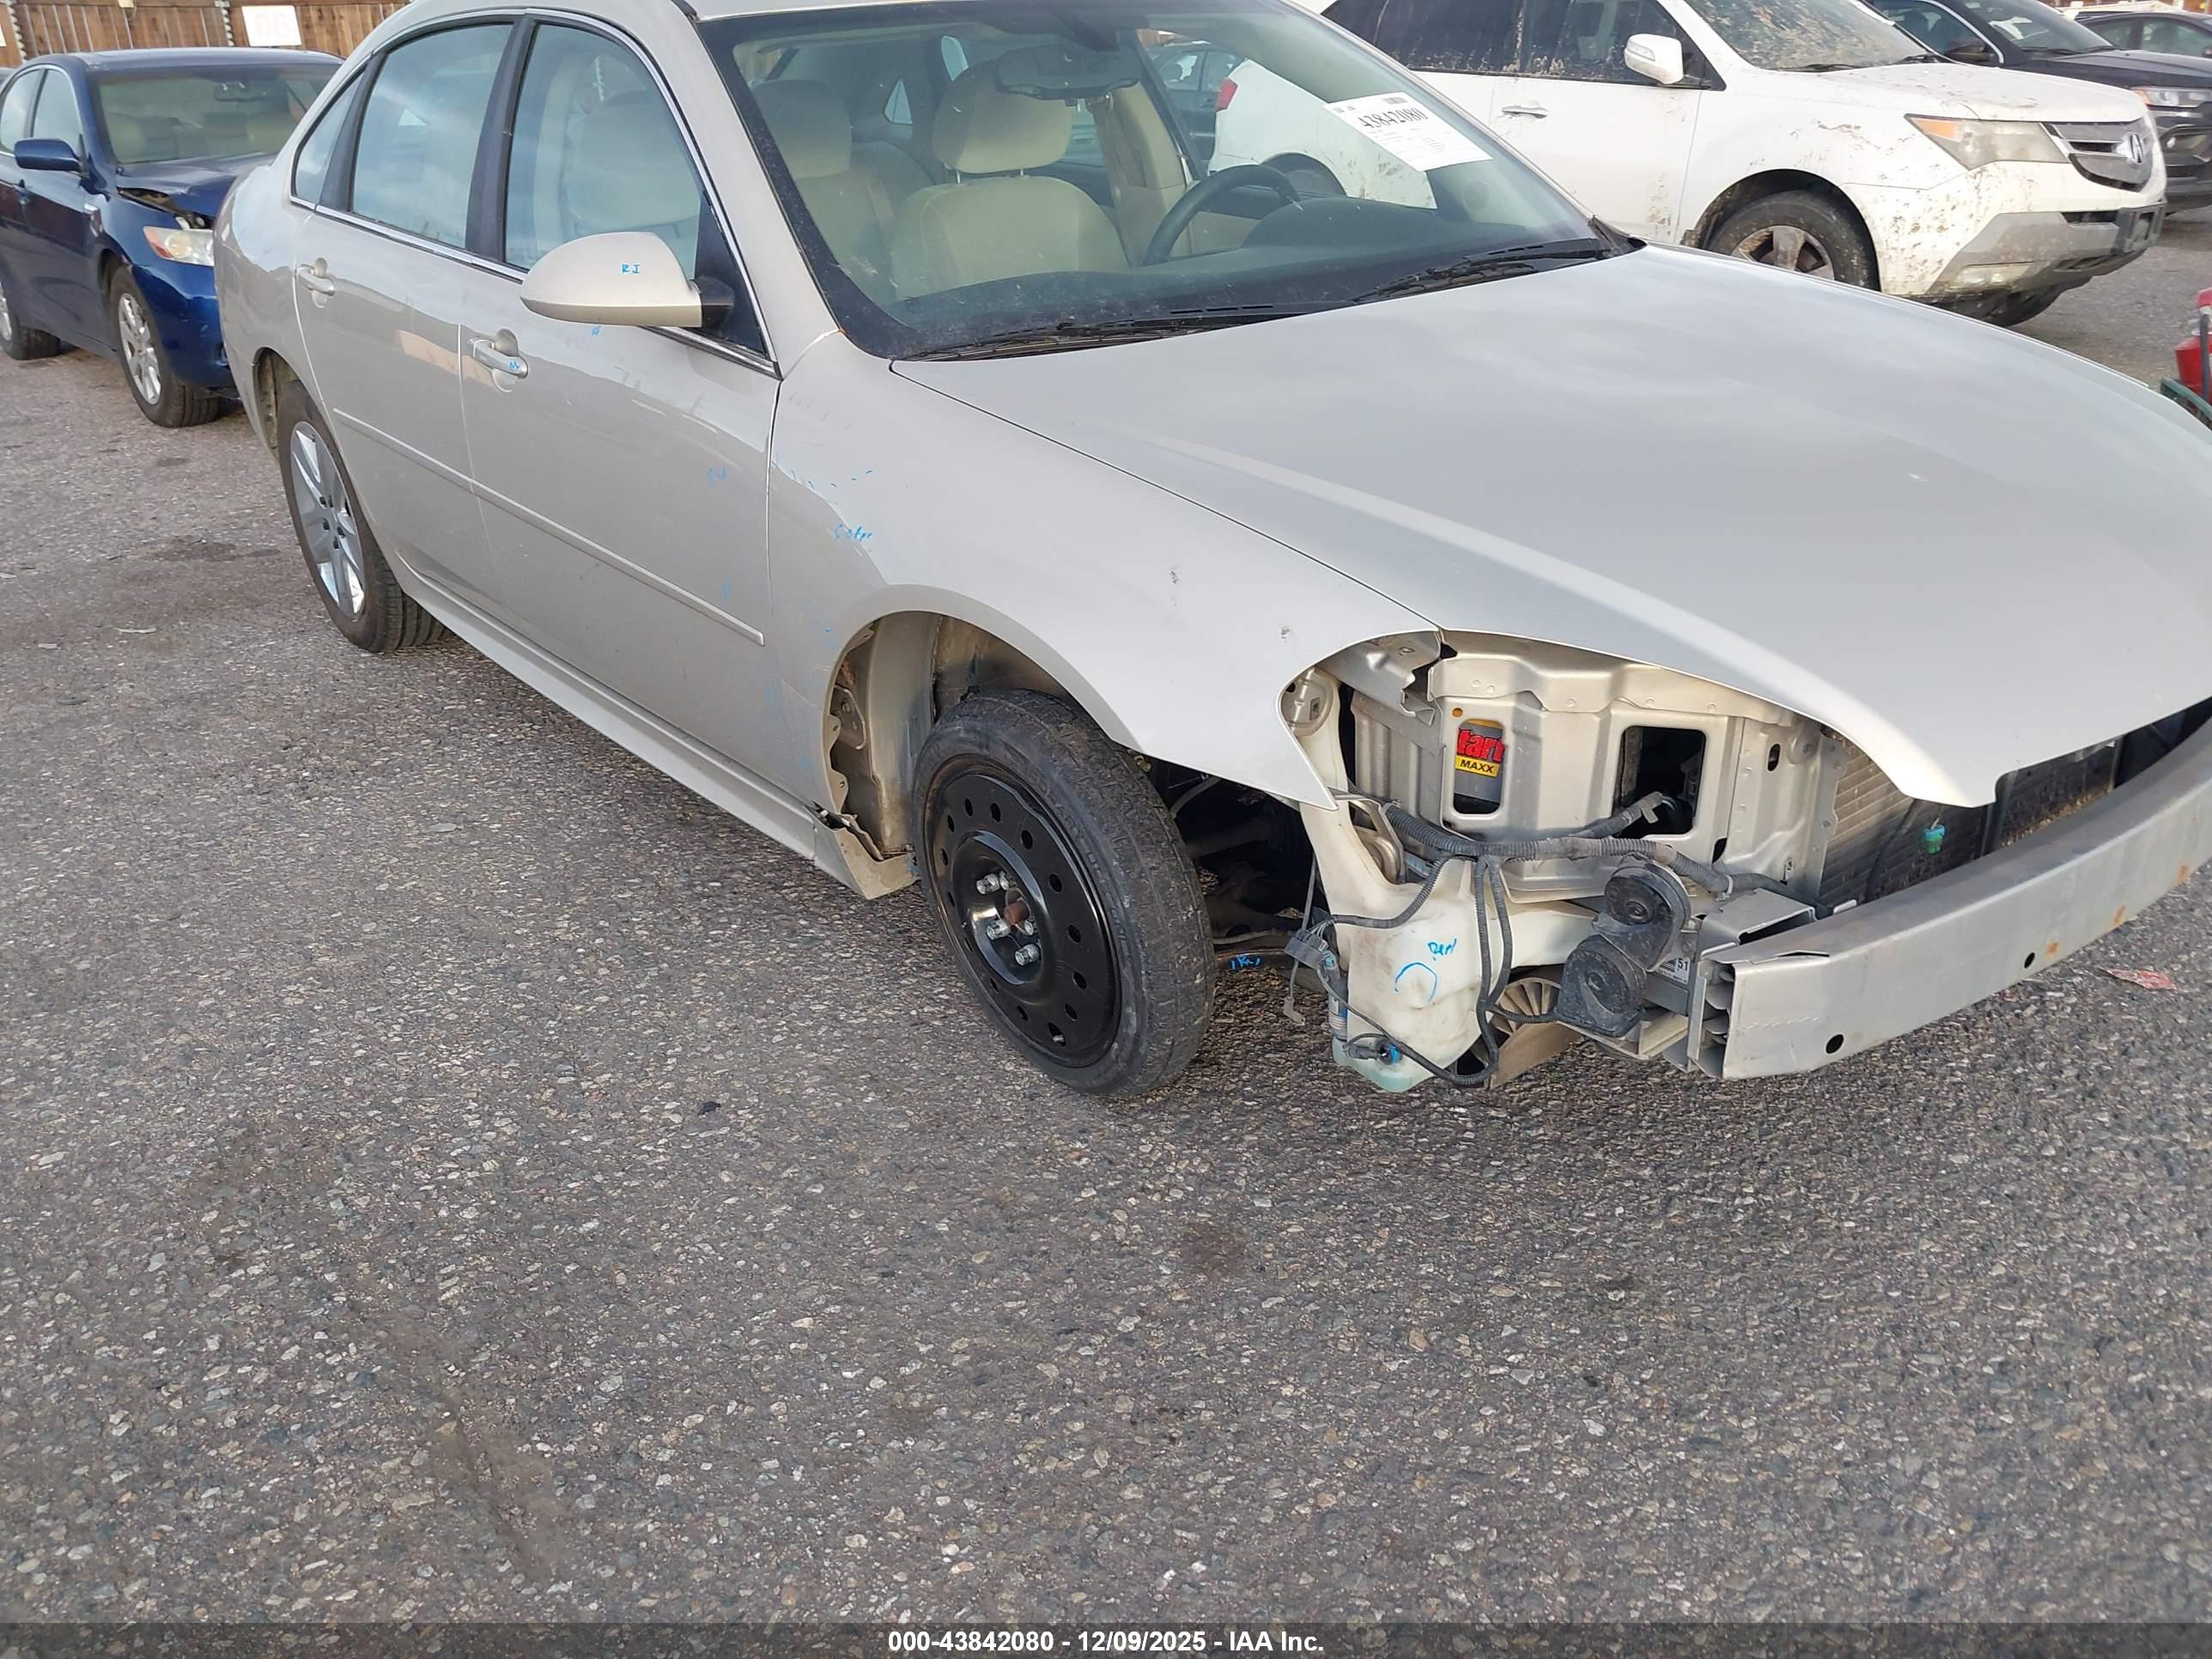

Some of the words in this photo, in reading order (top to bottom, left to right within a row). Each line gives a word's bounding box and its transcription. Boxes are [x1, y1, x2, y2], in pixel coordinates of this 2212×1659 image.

[1358, 107, 1429, 129] 43842080
[1460, 759, 1494, 774] MAXX
[1677, 957, 1688, 972] 51
